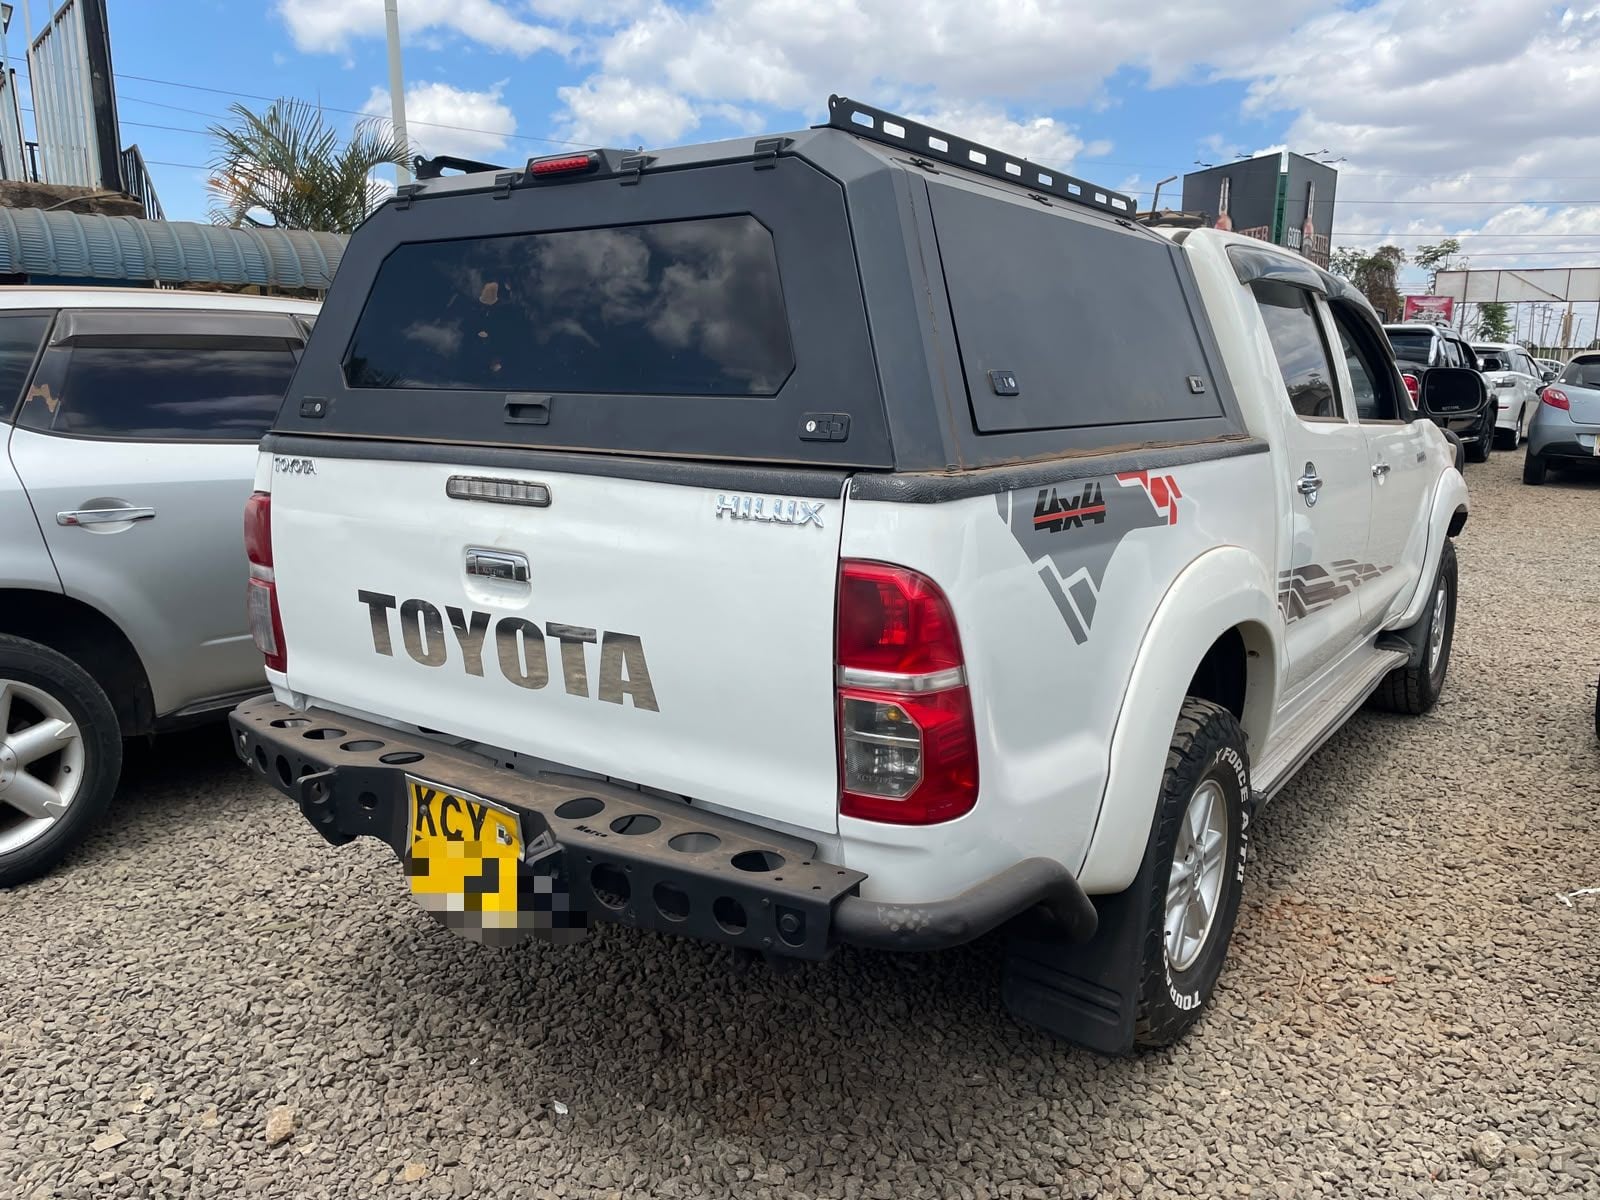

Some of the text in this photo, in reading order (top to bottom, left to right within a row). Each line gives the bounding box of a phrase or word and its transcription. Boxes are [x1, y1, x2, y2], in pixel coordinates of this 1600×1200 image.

[274, 458, 318, 475] TOYOTA
[716, 494, 825, 528] HILUX
[1033, 481, 1106, 534] 4x4
[357, 589, 660, 712] TOYOTA
[414, 783, 488, 841] KCY
